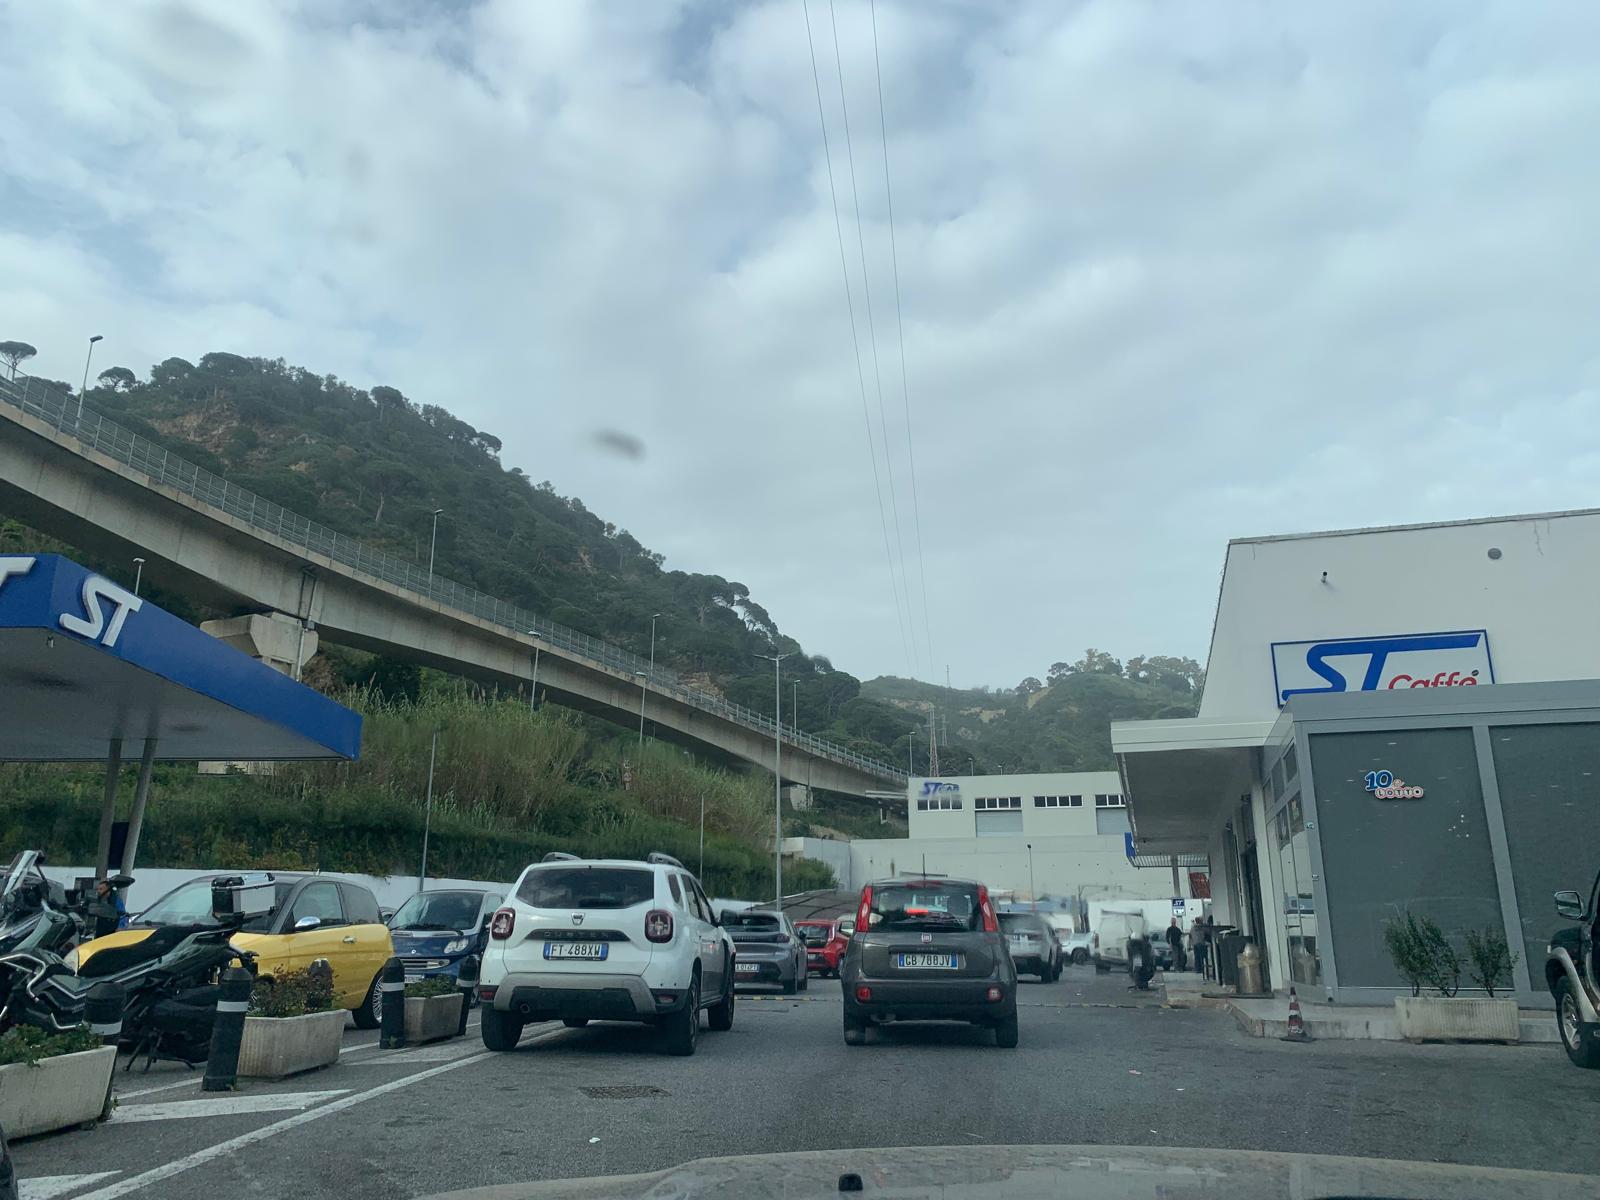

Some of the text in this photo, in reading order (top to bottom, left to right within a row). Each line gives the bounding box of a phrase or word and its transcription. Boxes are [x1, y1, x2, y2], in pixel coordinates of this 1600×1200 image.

[59, 574, 143, 647] ST
[1281, 633, 1481, 701] ST
[1365, 770, 1393, 791] 10
[1375, 786, 1424, 799] LOTTO
[551, 944, 564, 956] FT
